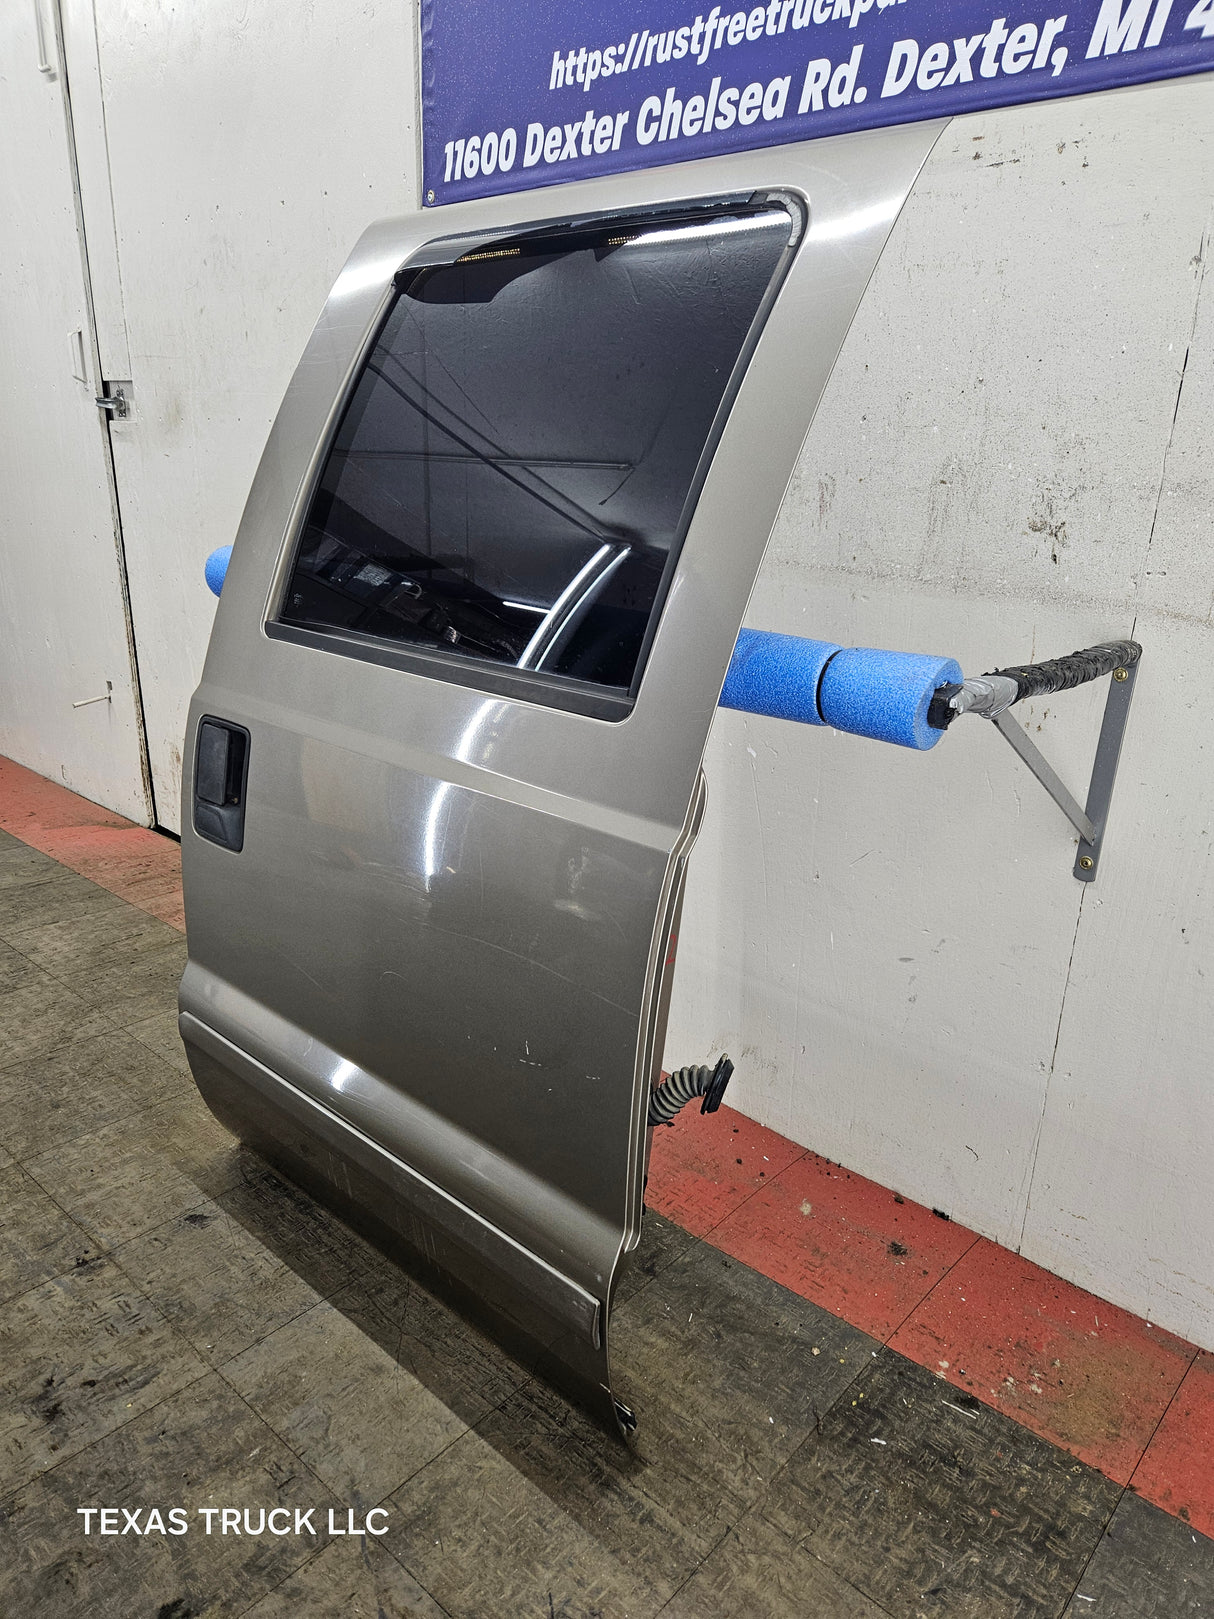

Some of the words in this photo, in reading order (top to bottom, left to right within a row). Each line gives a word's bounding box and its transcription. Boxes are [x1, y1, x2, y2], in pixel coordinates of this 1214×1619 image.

[443, 128, 517, 183] 11600
[523, 110, 630, 168] Dexter
[635, 76, 792, 146] Chelsea
[797, 45, 868, 115] Rd.
[880, 14, 1069, 98] Dexter,
[1085, 0, 1174, 59] MI
[549, 0, 907, 91] https://rustfreetruckp
